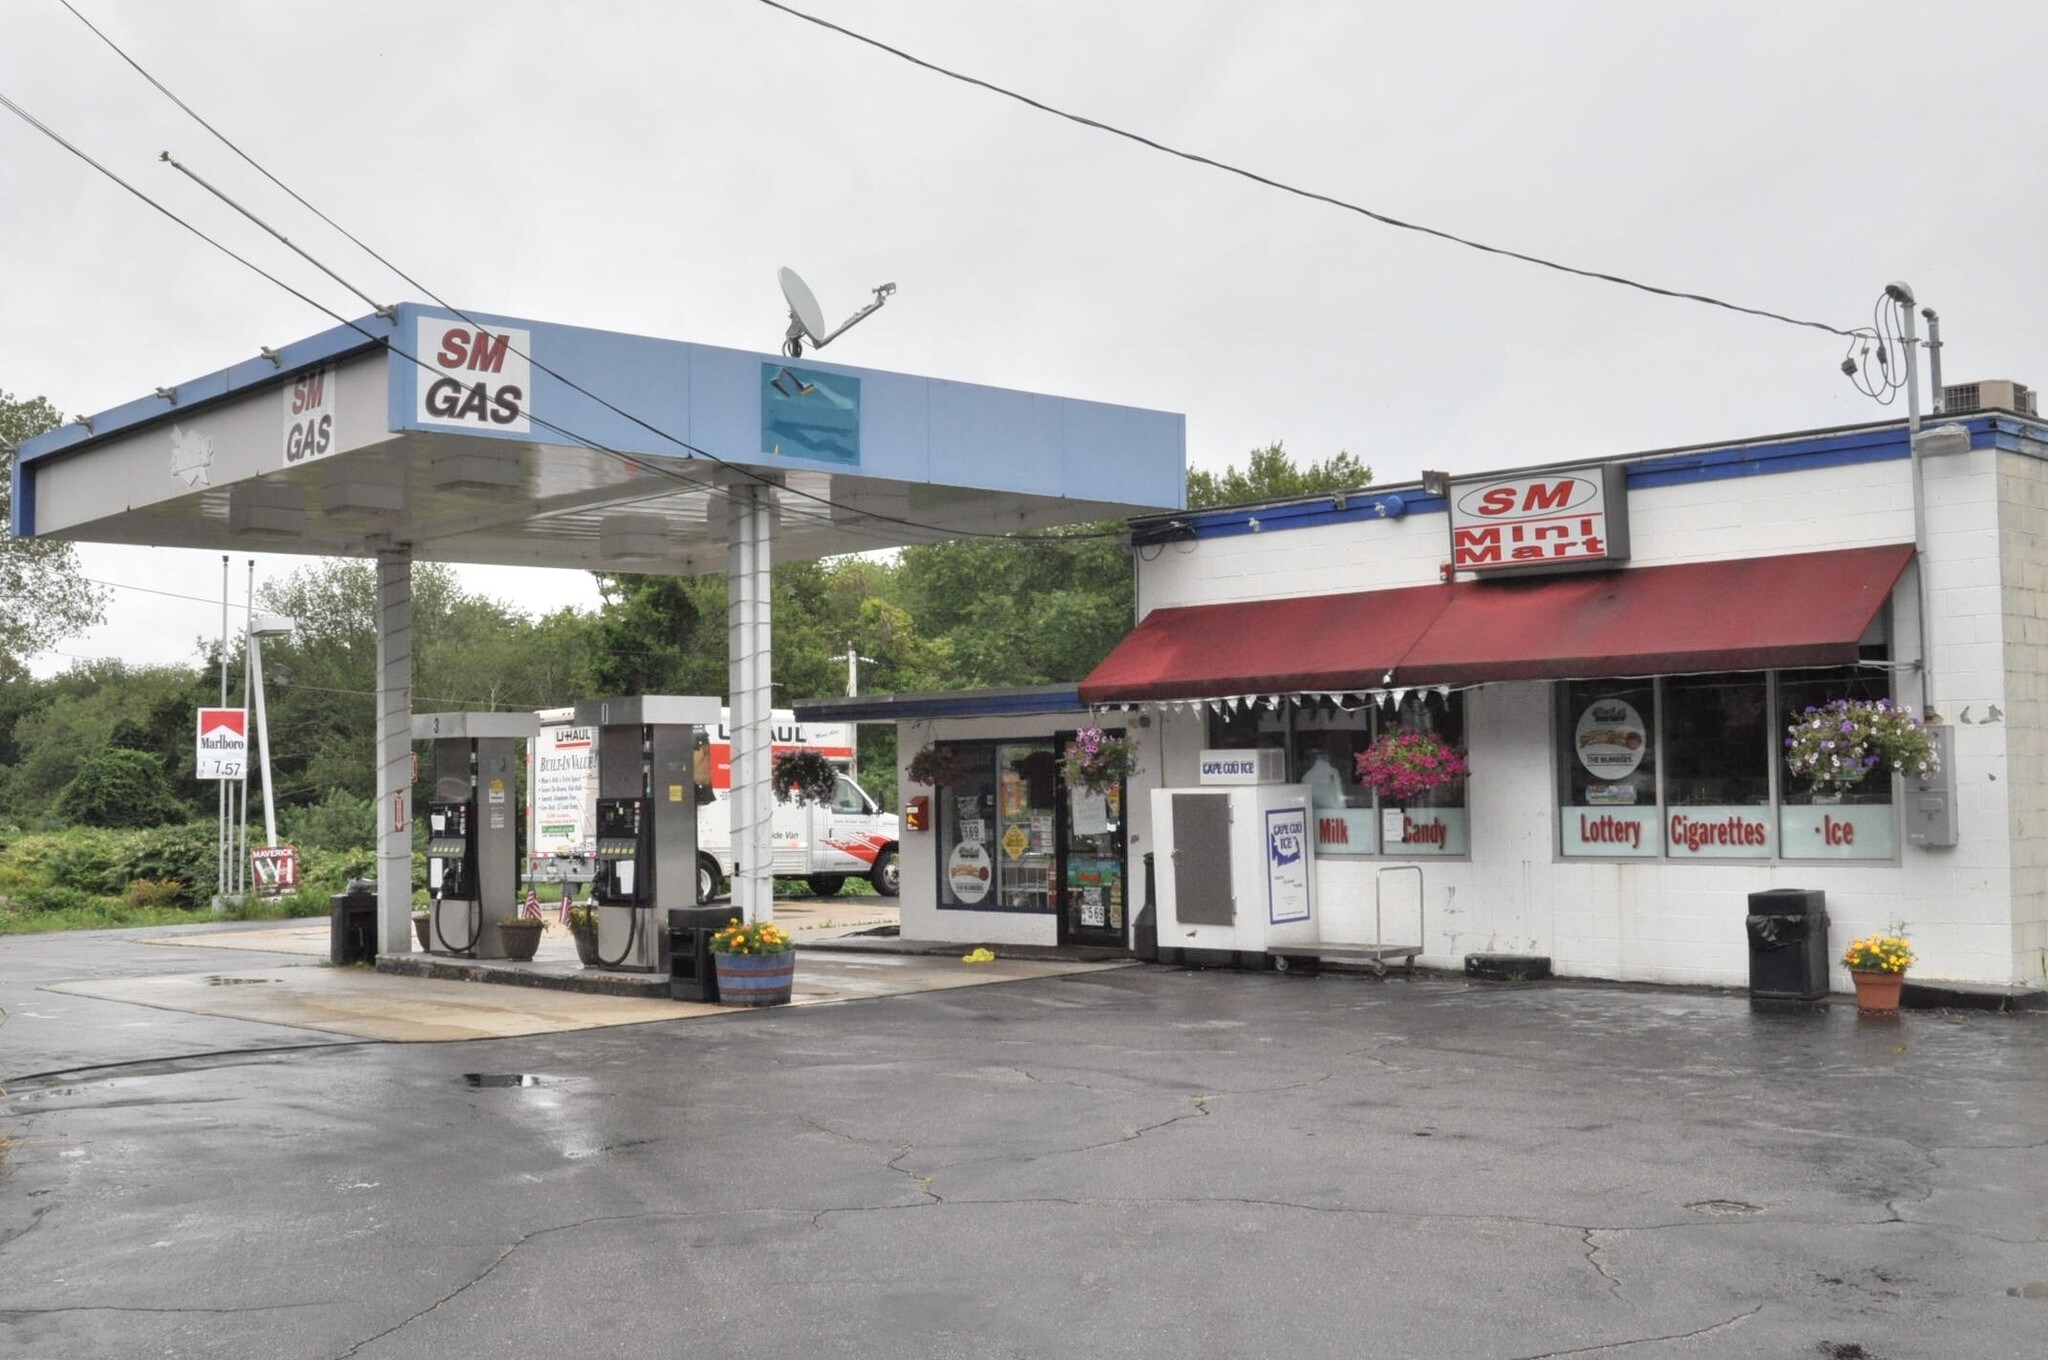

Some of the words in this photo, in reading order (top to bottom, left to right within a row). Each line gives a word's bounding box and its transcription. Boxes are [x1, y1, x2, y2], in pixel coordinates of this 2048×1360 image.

[437, 328, 510, 374] SM
[292, 370, 325, 416] SM
[425, 377, 523, 425] GAS
[286, 413, 332, 463] GAS
[1477, 480, 1575, 515] SM
[1455, 536, 1605, 564] Mart
[201, 734, 244, 749] Marlboro
[556, 729, 591, 742] U-HAUL
[214, 760, 241, 776] 7.57
[1240, 761, 1254, 774] ICE
[786, 831, 799, 839] Van
[1280, 837, 1292, 849] ICE
[1319, 817, 1349, 844] Milk
[1403, 816, 1447, 850] Candy
[1580, 813, 1641, 849] Lottery
[1670, 814, 1766, 851] Cigarettes
[252, 849, 293, 858] MAVERICK
